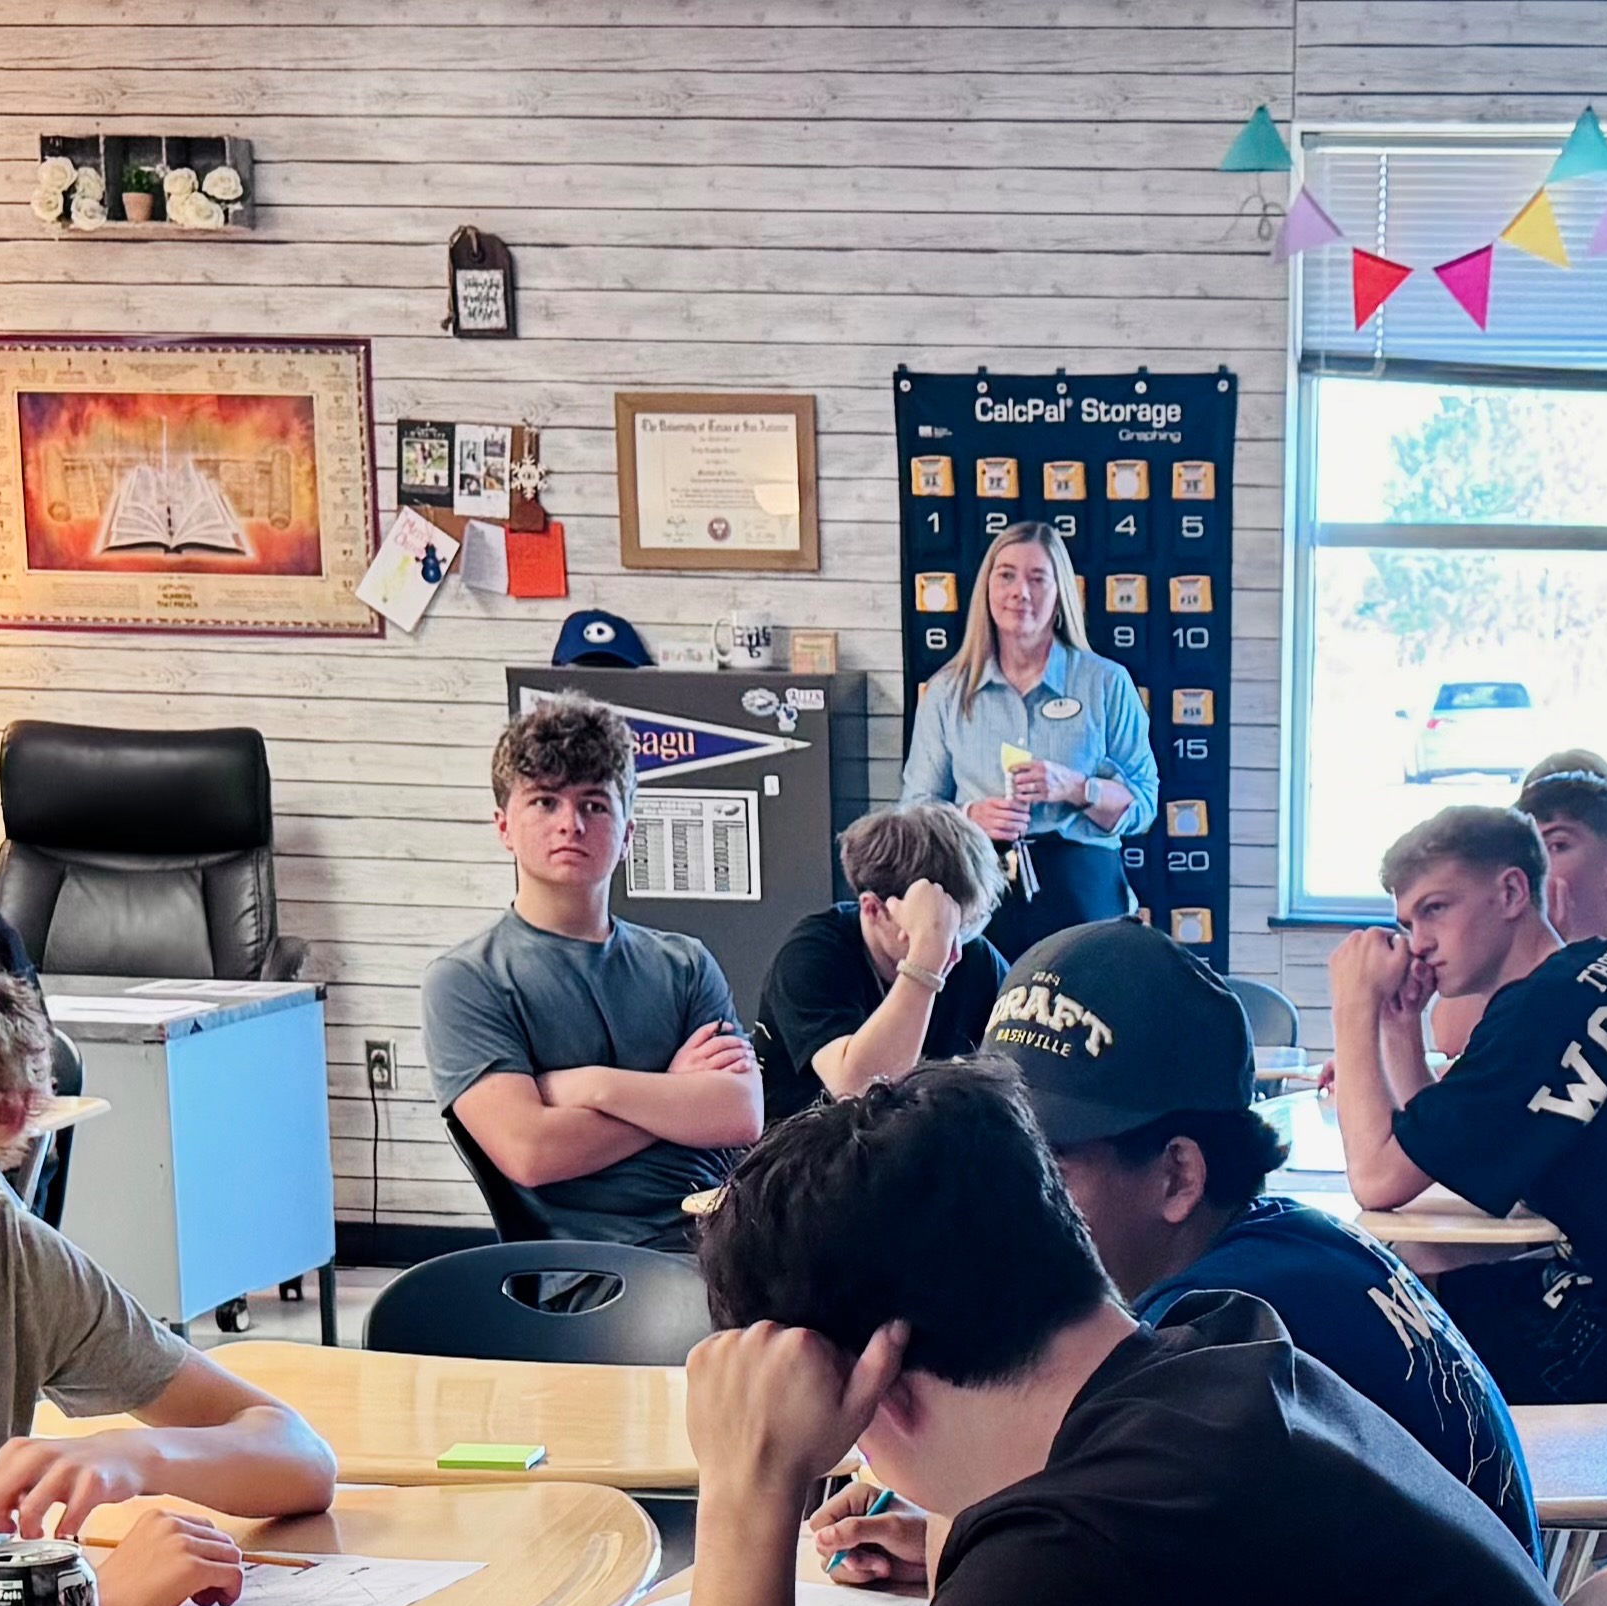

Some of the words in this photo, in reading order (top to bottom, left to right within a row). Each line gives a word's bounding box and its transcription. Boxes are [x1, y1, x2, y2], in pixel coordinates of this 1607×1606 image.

[1081, 398, 1182, 428] Storage
[1118, 428, 1182, 443] Graphing
[926, 512, 940, 534] 1
[985, 512, 1009, 535] 2
[1054, 514, 1077, 538] 3
[1114, 514, 1137, 537] 4
[1181, 516, 1205, 538] 5
[925, 627, 948, 651] 6
[1113, 625, 1136, 649] 9
[1172, 626, 1210, 650] 10
[1172, 738, 1209, 761] 15
[1167, 850, 1210, 872] 20
[984, 985, 1113, 1058] DRAFT
[995, 1028, 1072, 1058] NASHVILLE
